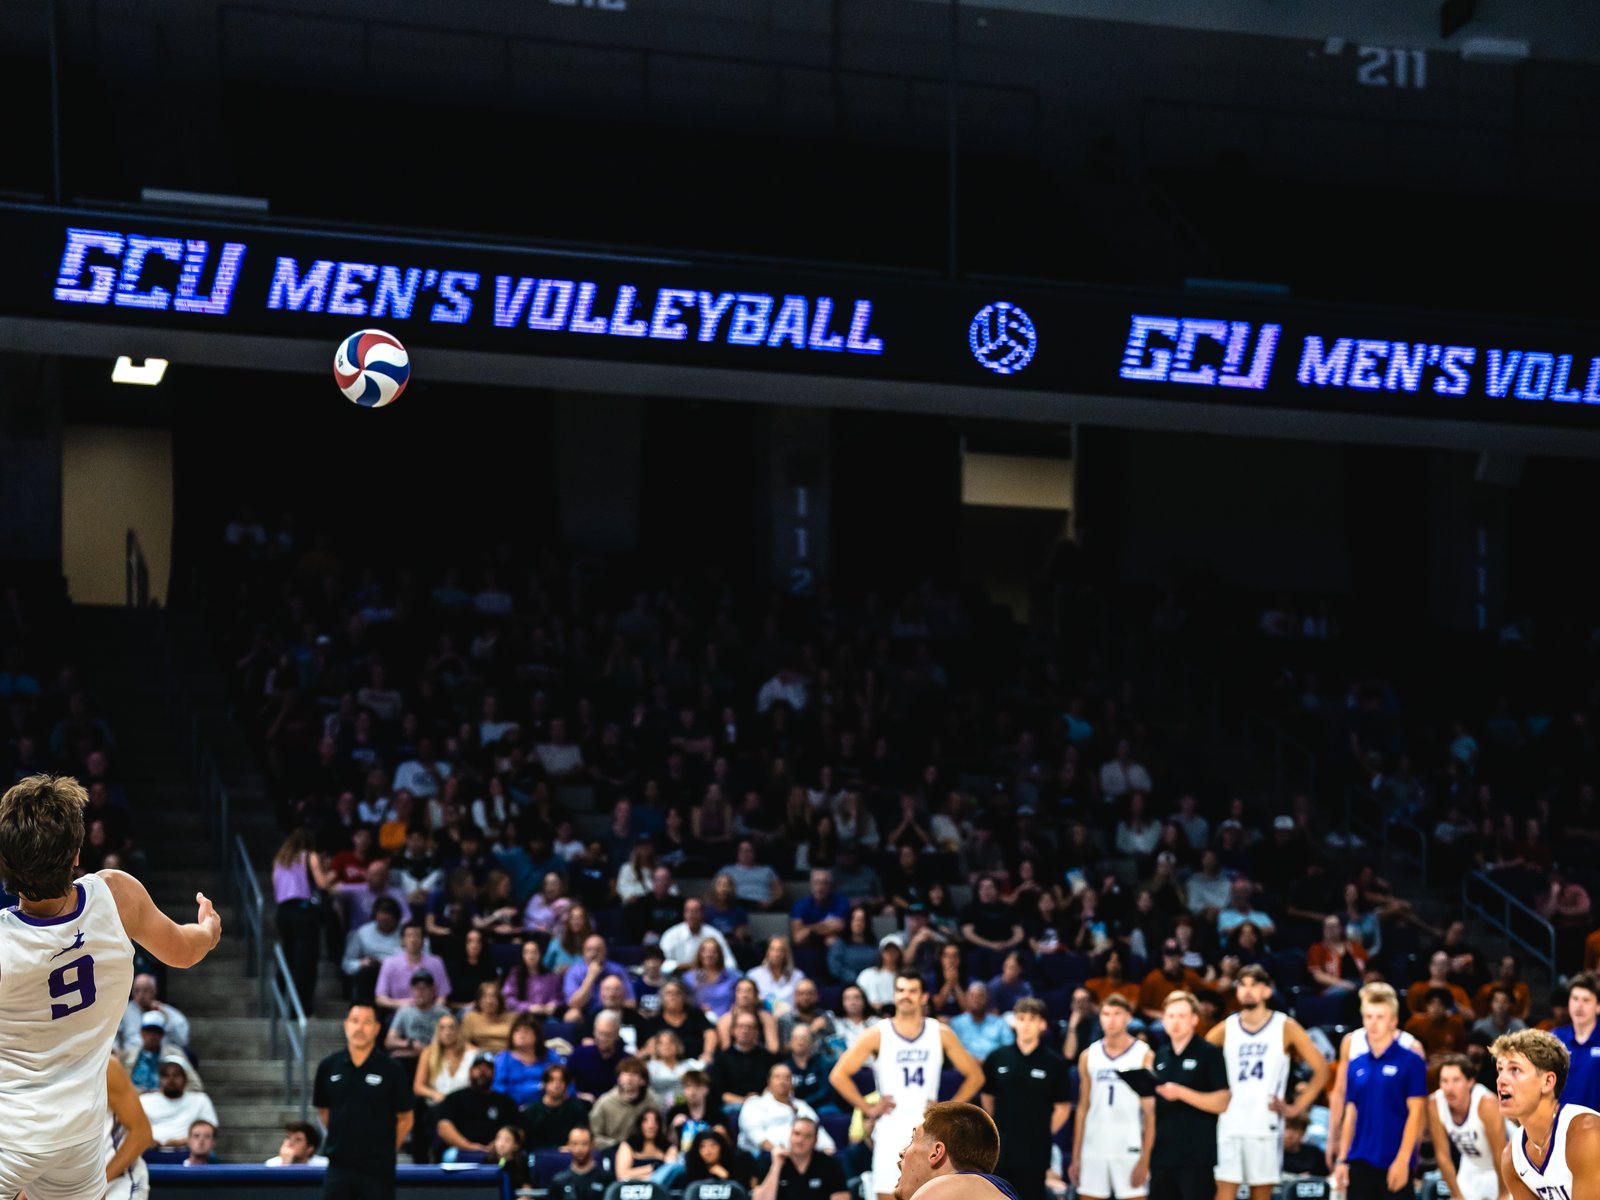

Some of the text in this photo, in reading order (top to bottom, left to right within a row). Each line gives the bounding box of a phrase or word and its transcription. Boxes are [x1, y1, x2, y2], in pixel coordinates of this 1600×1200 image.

[1356, 45, 1427, 88] 211
[53, 227, 884, 354] GCU MEN'S VOLLEYBALL
[1118, 313, 1282, 389] GCU
[1296, 335, 1477, 396] MEN'S
[48, 954, 97, 1020] 9
[902, 1066, 925, 1087] 14
[1237, 1060, 1264, 1082] 24
